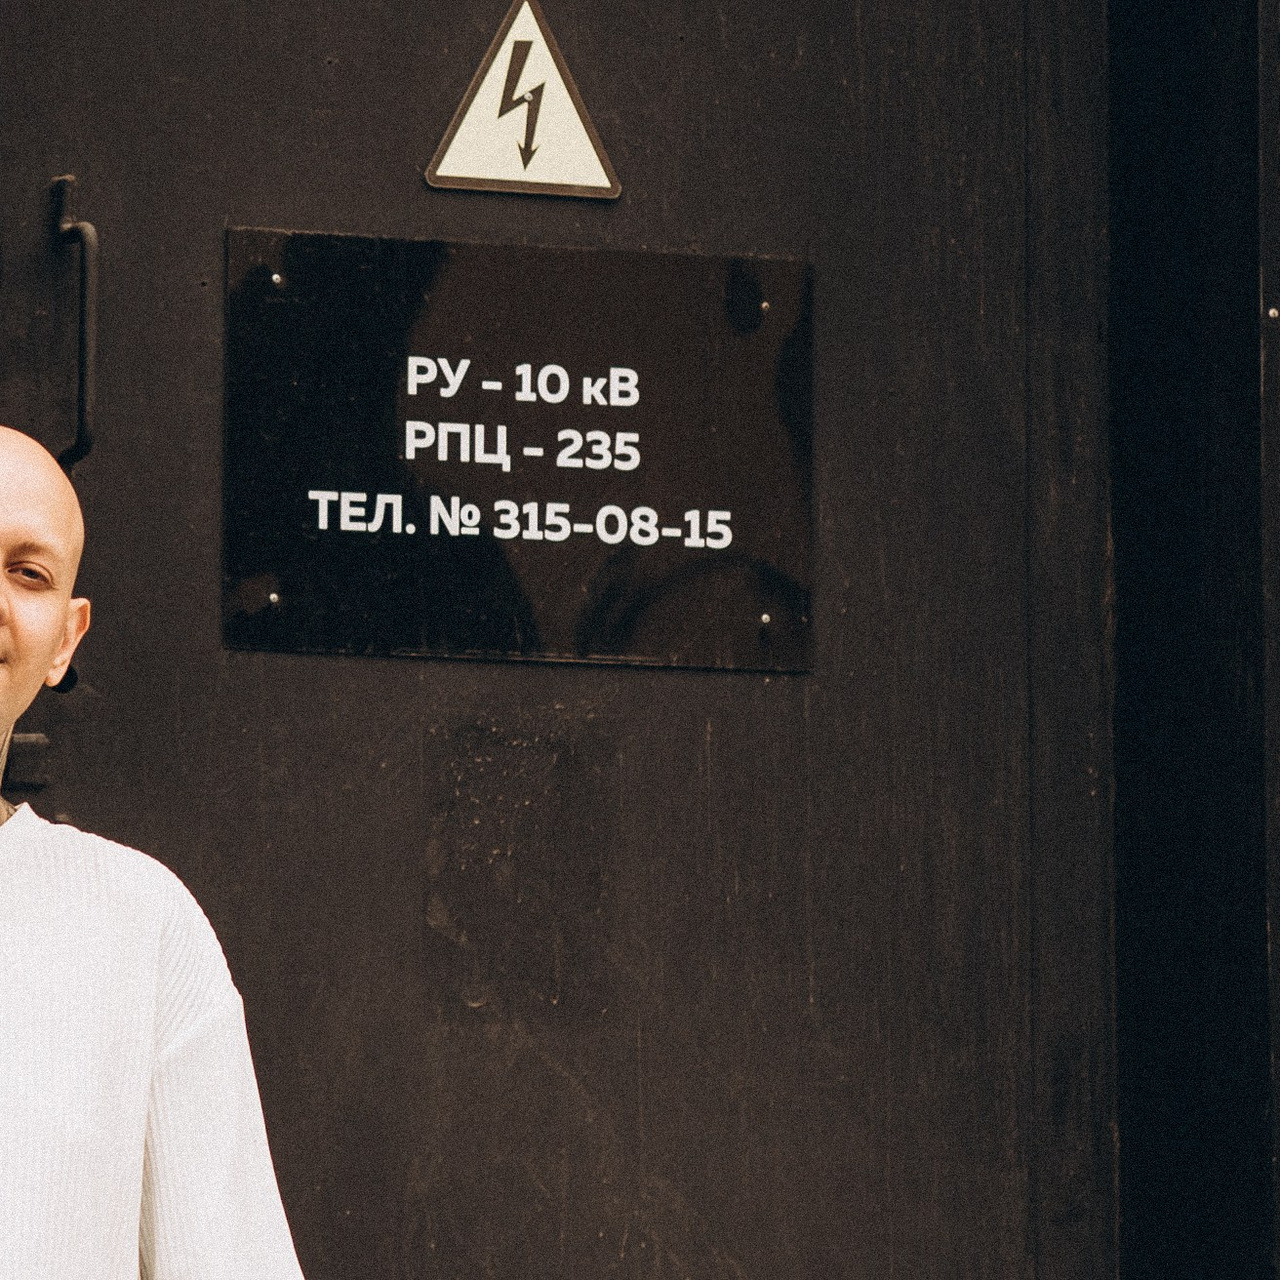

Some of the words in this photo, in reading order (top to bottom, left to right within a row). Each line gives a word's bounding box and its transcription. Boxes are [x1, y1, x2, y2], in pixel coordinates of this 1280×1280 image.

[407, 355, 471, 398] РУ
[514, 363, 570, 404] 10
[582, 366, 640, 407] кВ
[405, 420, 512, 473] РПЦ
[555, 428, 641, 471] 235
[307, 489, 416, 535] ТЕЛ.
[429, 494, 481, 537] №
[493, 499, 733, 550] 315-08-15
